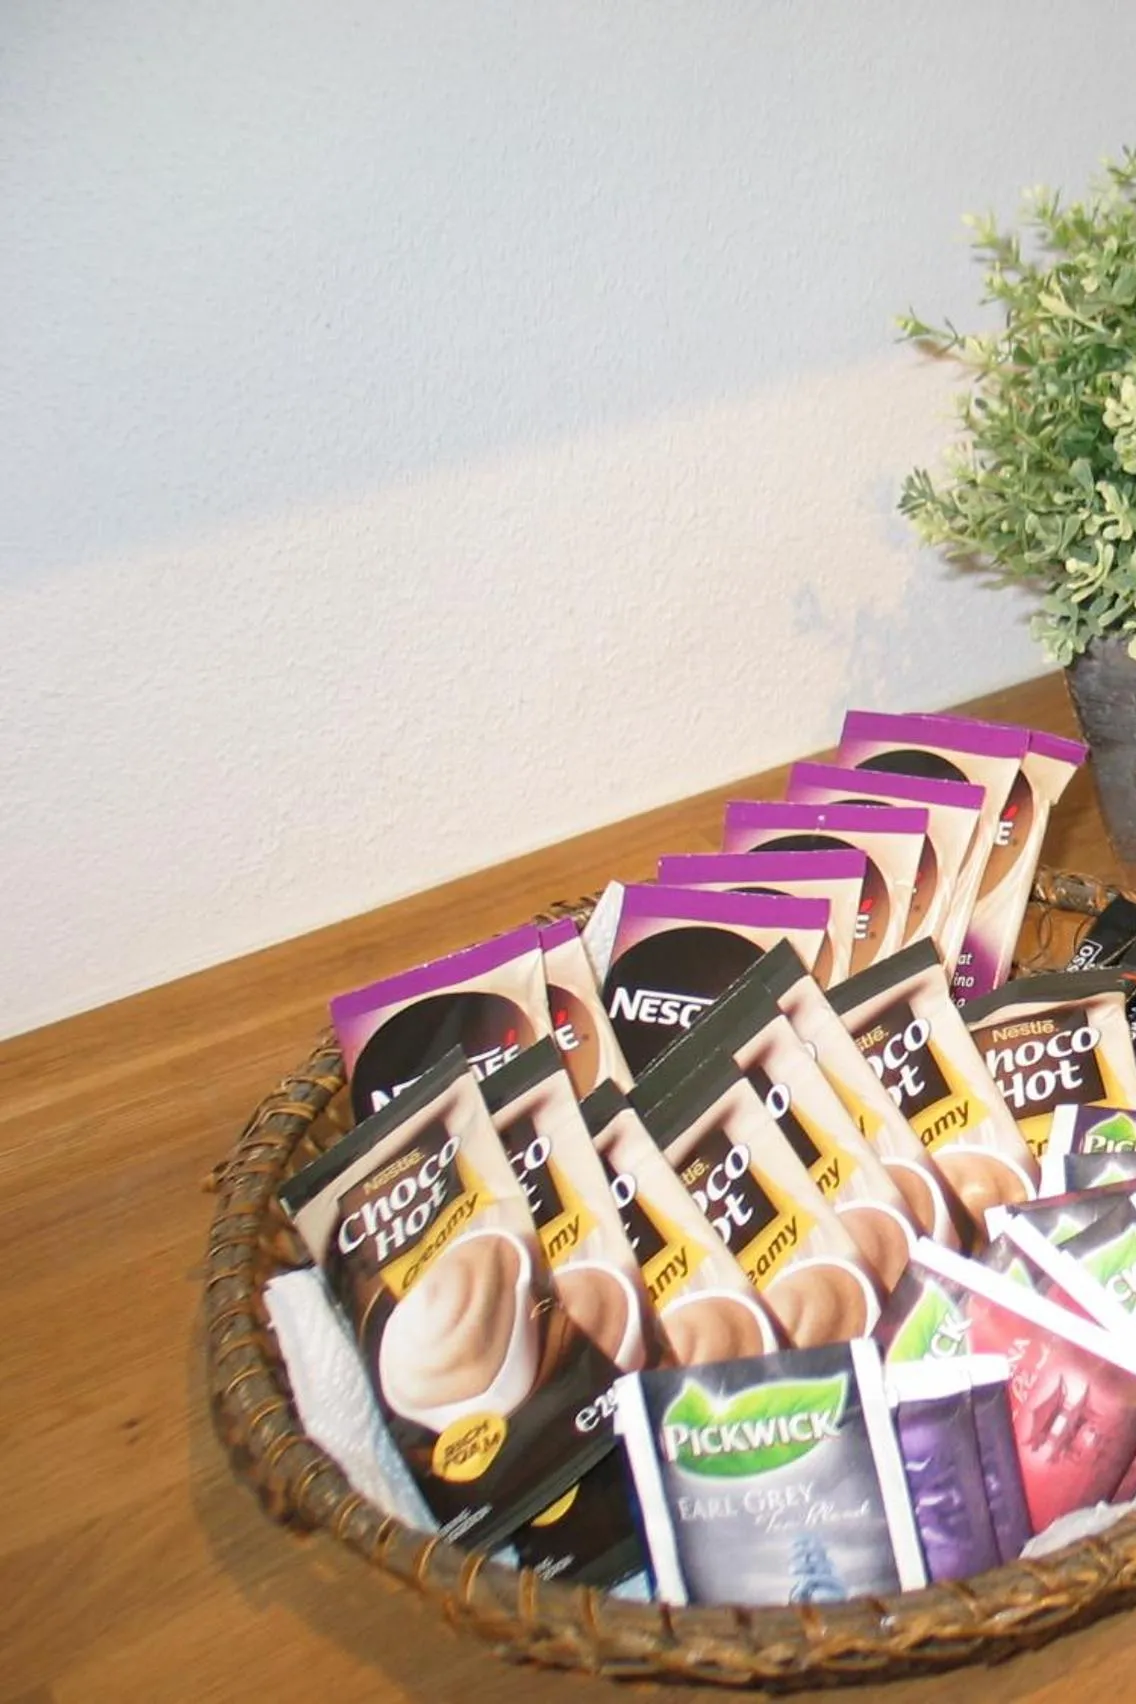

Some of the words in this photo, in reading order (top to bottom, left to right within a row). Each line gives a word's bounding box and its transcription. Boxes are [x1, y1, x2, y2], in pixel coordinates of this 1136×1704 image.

[992, 1019, 1056, 1042] Nestlé
[662, 1410, 842, 1462] PICKWICK
[678, 1495, 738, 1522] EARL
[744, 1483, 814, 1516] GREY
